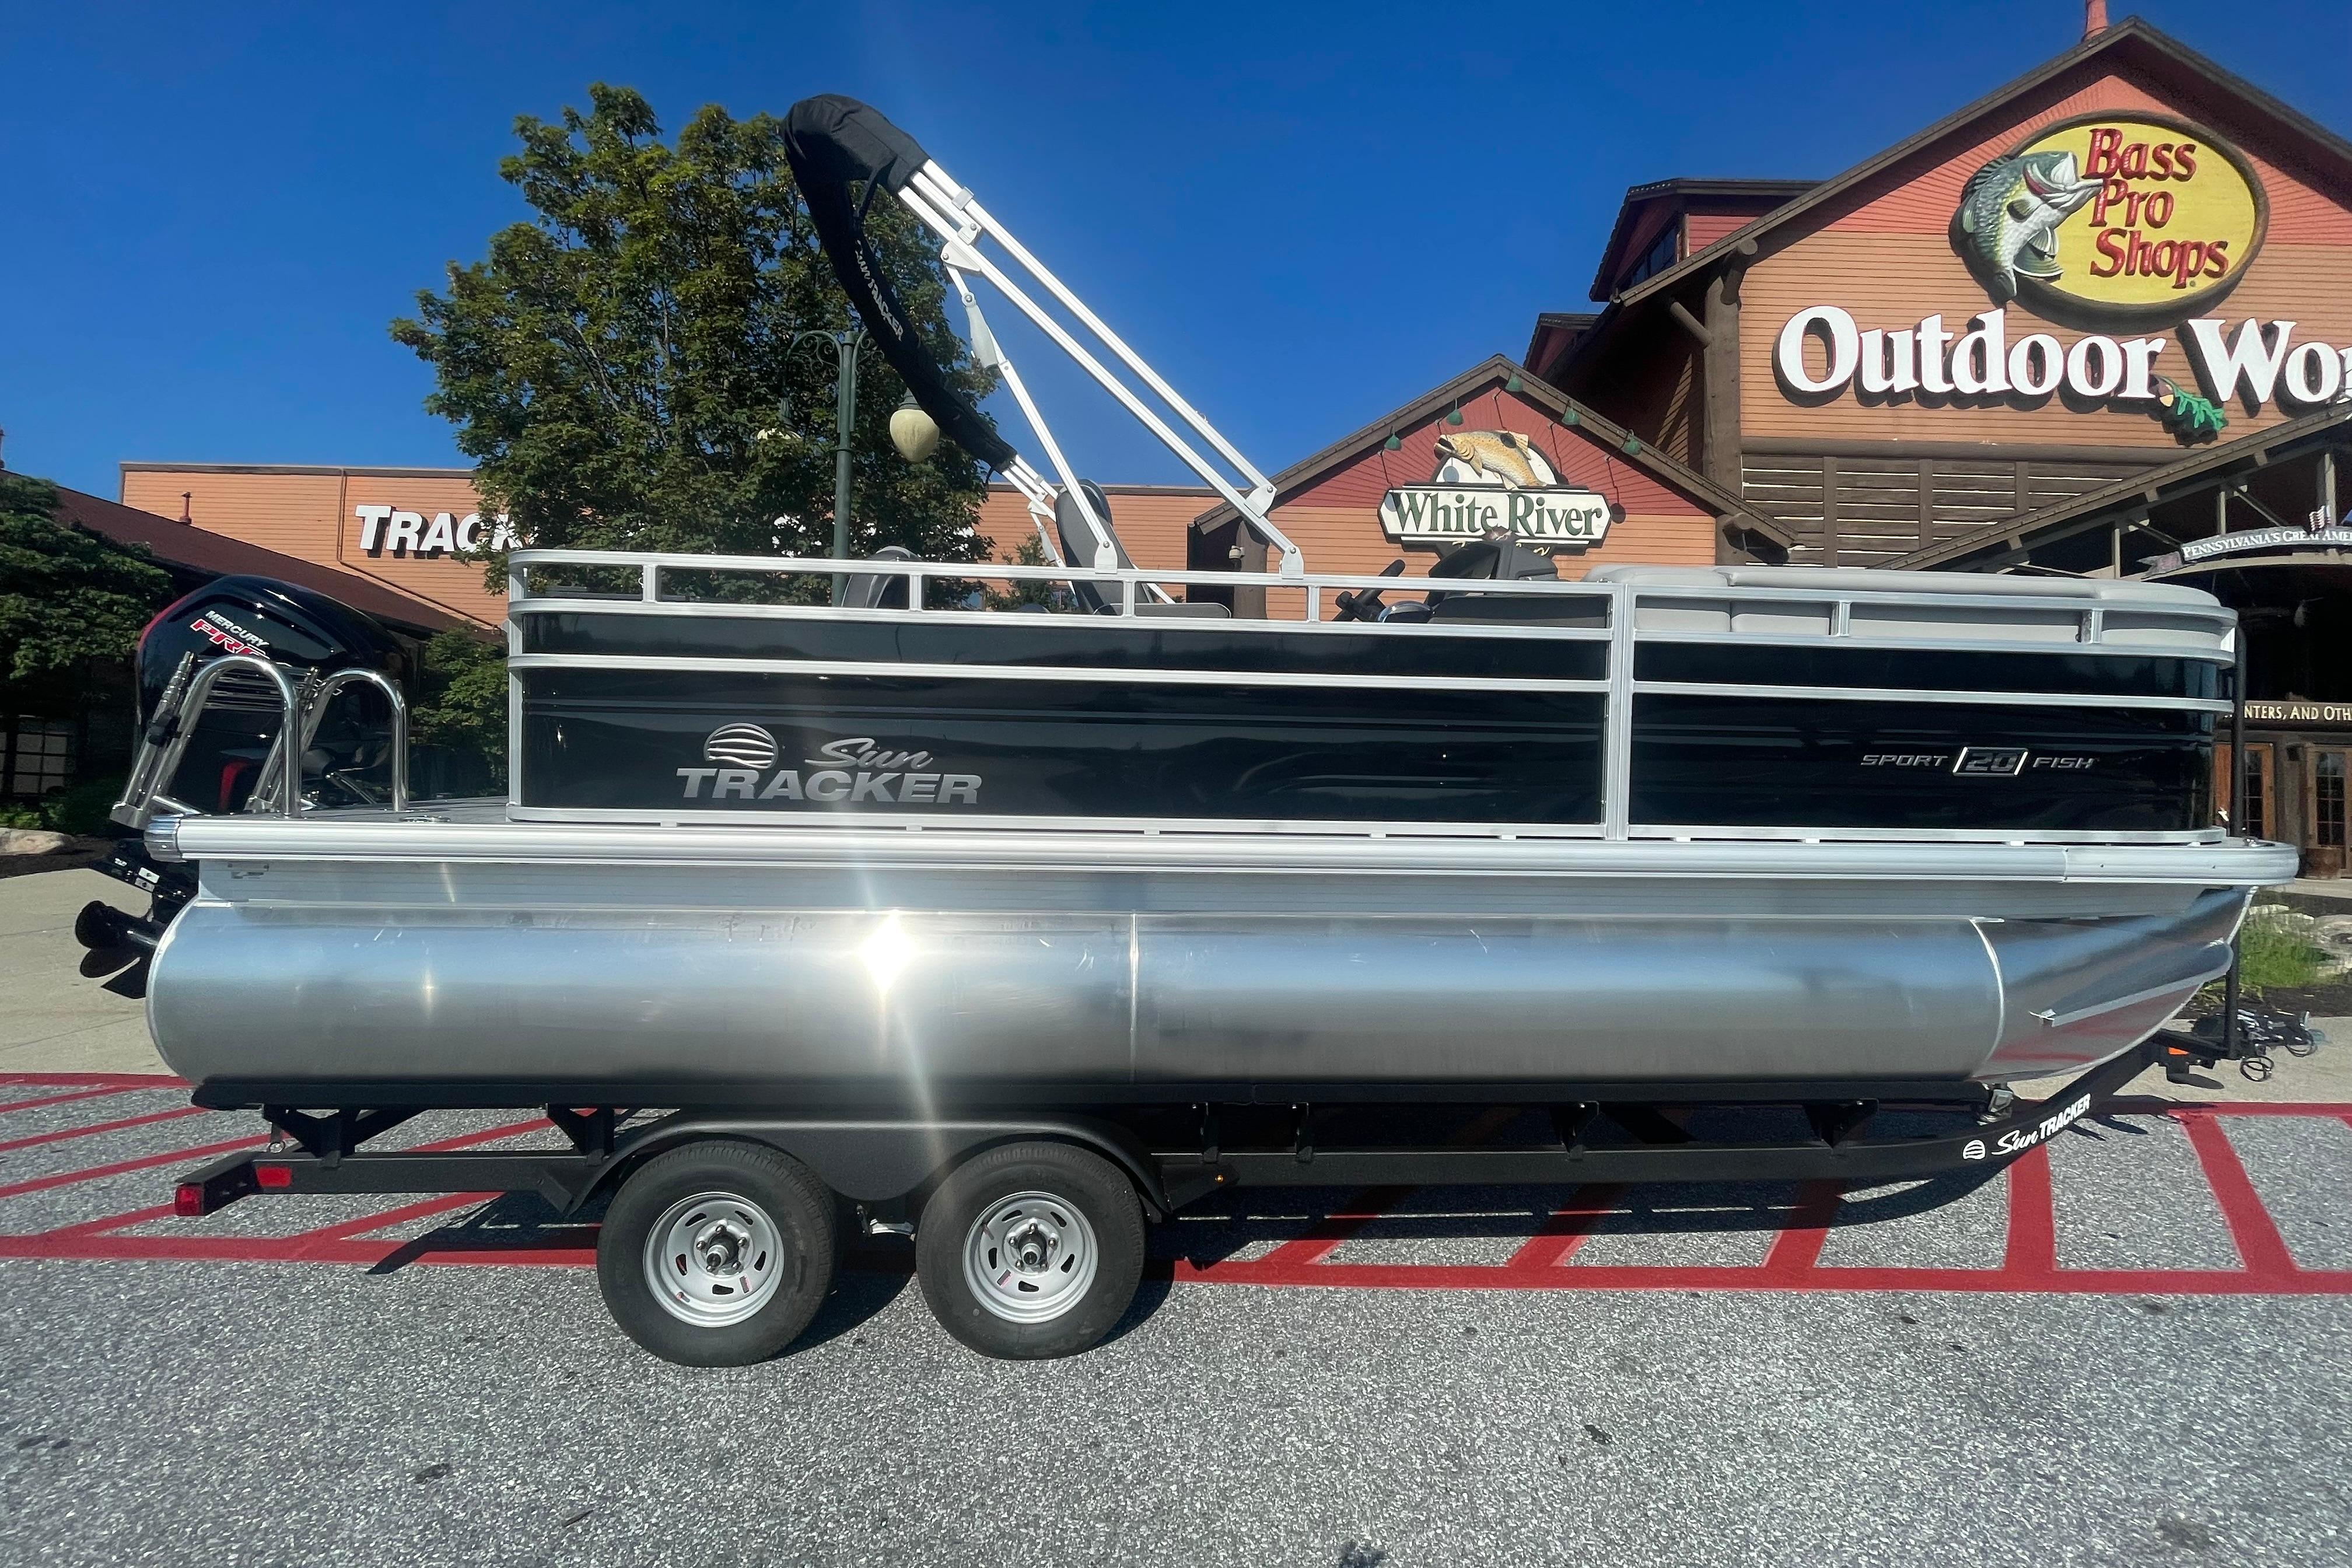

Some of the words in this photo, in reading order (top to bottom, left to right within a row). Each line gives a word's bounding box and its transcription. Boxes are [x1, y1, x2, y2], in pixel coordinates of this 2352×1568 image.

[2082, 128, 2197, 181] Bass
[2088, 178, 2174, 229] Pro
[2090, 228, 2229, 289] Shops
[1778, 304, 2166, 400] Outdoor
[2188, 317, 2352, 403] Wo
[355, 505, 539, 552] TRACK
[1391, 492, 1499, 533] White
[1506, 493, 1602, 538] River
[2183, 531, 2281, 558] PENNSYLVANIA'S
[2283, 530, 2320, 542] GRE
[2322, 530, 2352, 541] AME
[205, 610, 270, 647] MERCURY
[2224, 705, 2287, 720] NTERS,
[2290, 706, 2319, 720] AND
[2324, 706, 2352, 720] OTH
[804, 737, 933, 769] Sun
[1860, 755, 1948, 766] SPORT
[1965, 752, 2020, 771] 20
[2032, 757, 2096, 769] FISH
[676, 768, 982, 804] TRACKER
[1991, 1129, 2039, 1156] Sun
[2039, 1093, 2092, 1139] TRACKER
